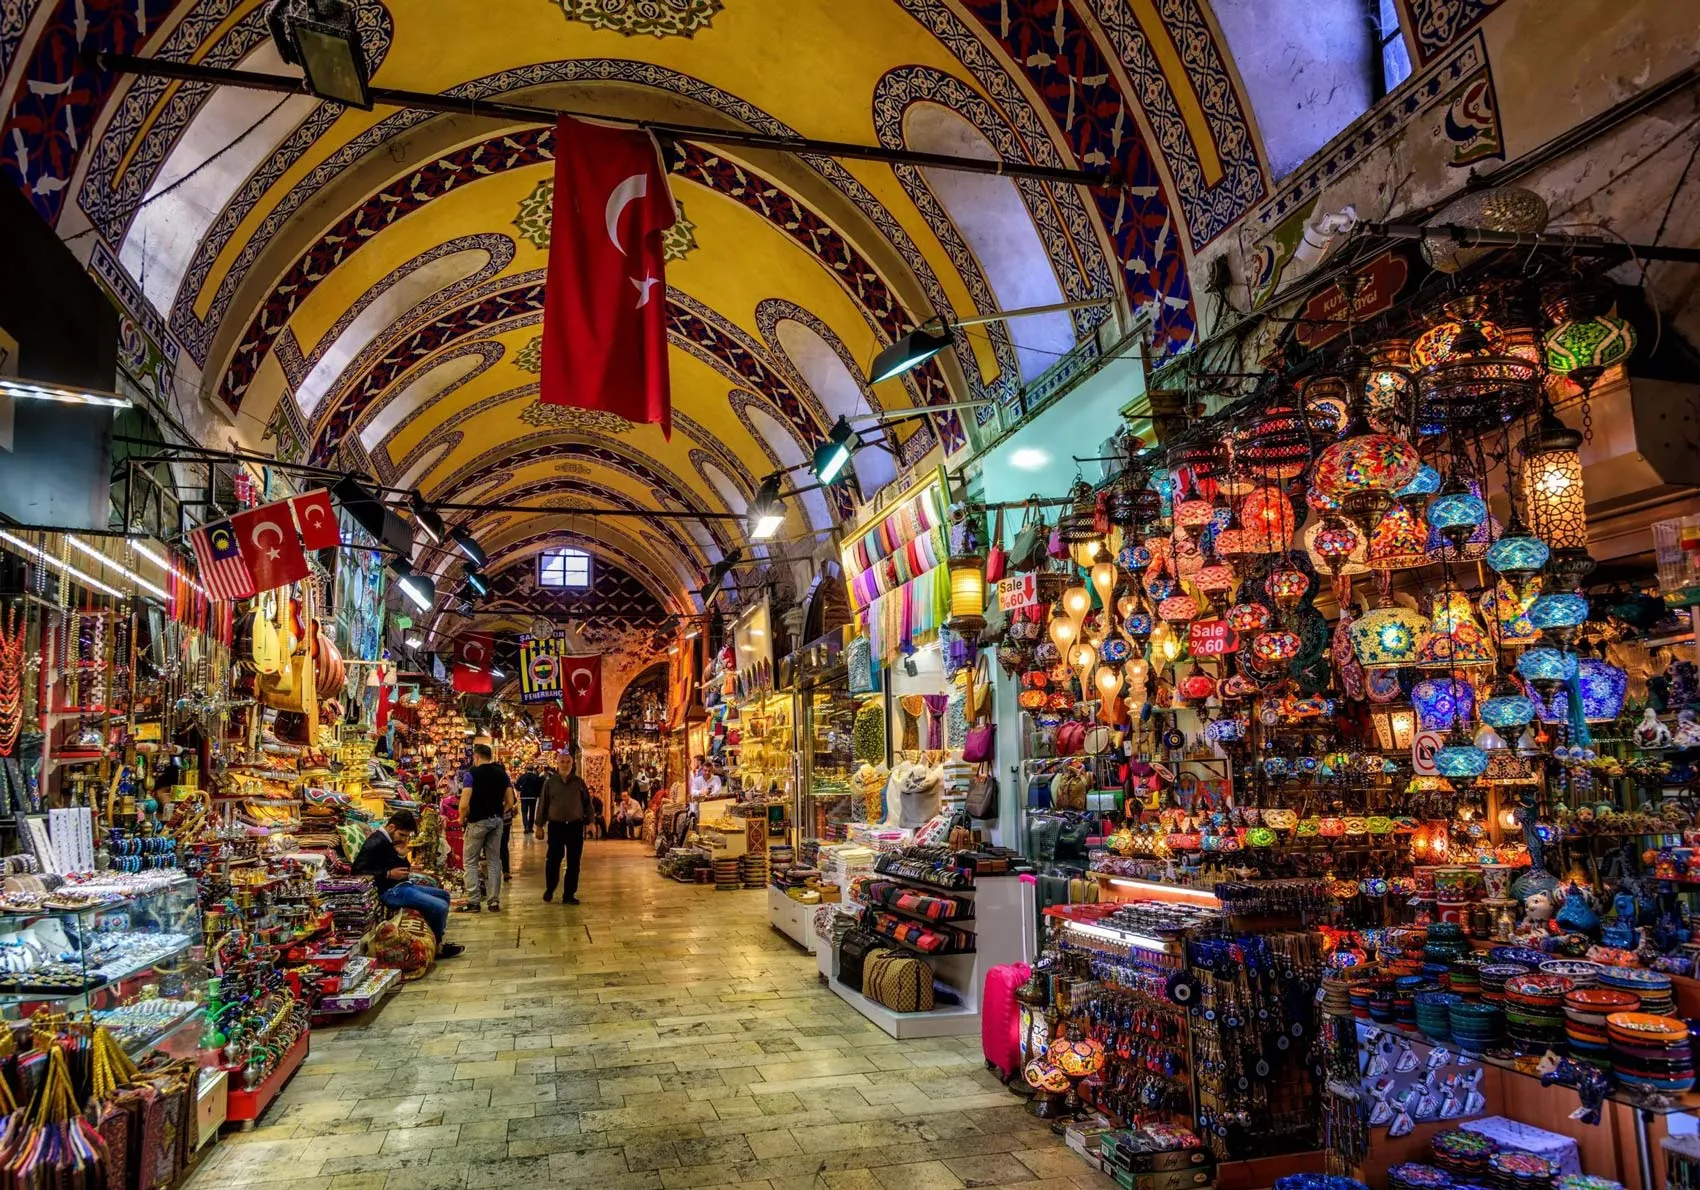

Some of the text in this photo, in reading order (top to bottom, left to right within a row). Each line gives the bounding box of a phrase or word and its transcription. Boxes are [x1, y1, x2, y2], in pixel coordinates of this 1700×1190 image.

[1000, 579, 1022, 593] Sale
[1000, 592, 1024, 608] %60
[1192, 624, 1224, 637] Sale
[1192, 639, 1224, 654] %60
[524, 690, 563, 701] FENERBAHÇ
